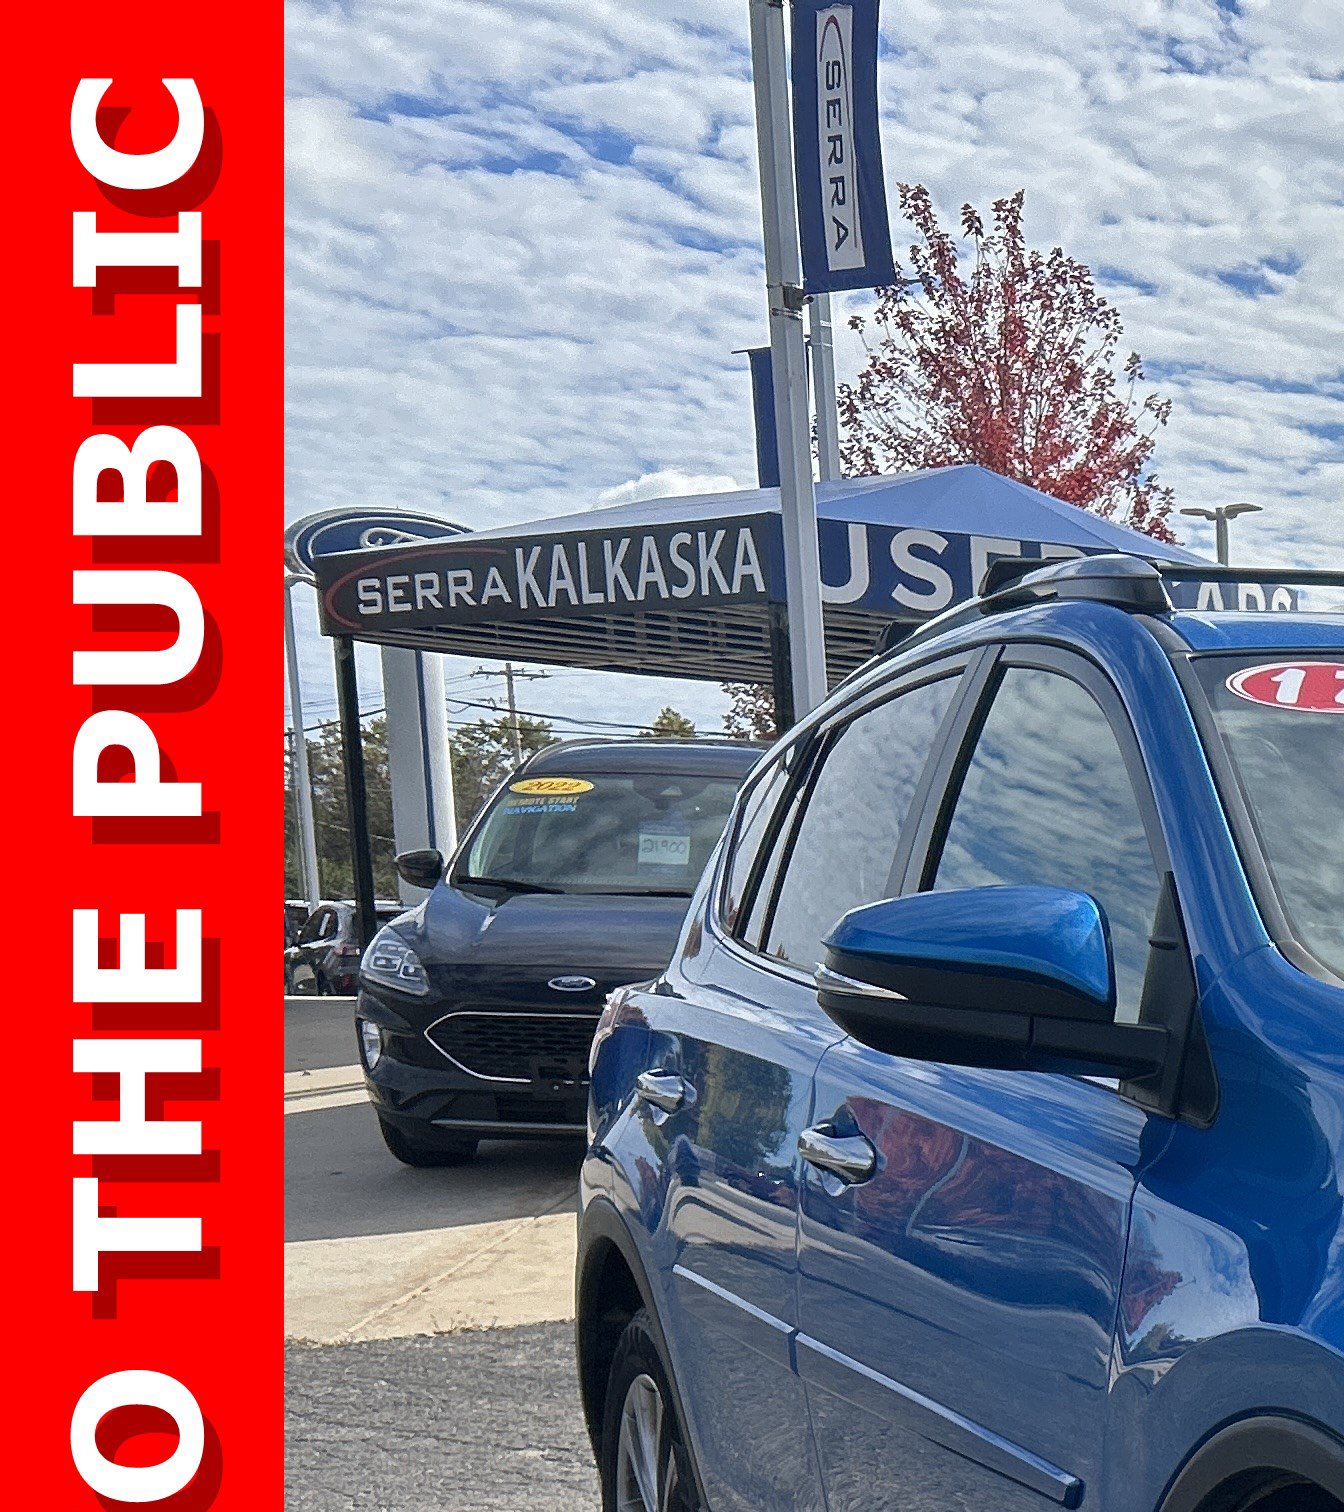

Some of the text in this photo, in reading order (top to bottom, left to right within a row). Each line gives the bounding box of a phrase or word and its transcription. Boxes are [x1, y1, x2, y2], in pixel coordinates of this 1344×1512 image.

[825, 60, 849, 252] SERRA
[356, 527, 767, 615] SERRA KALKASKA
[821, 523, 1088, 613] USE
[503, 804, 577, 815] NAVIGATION
